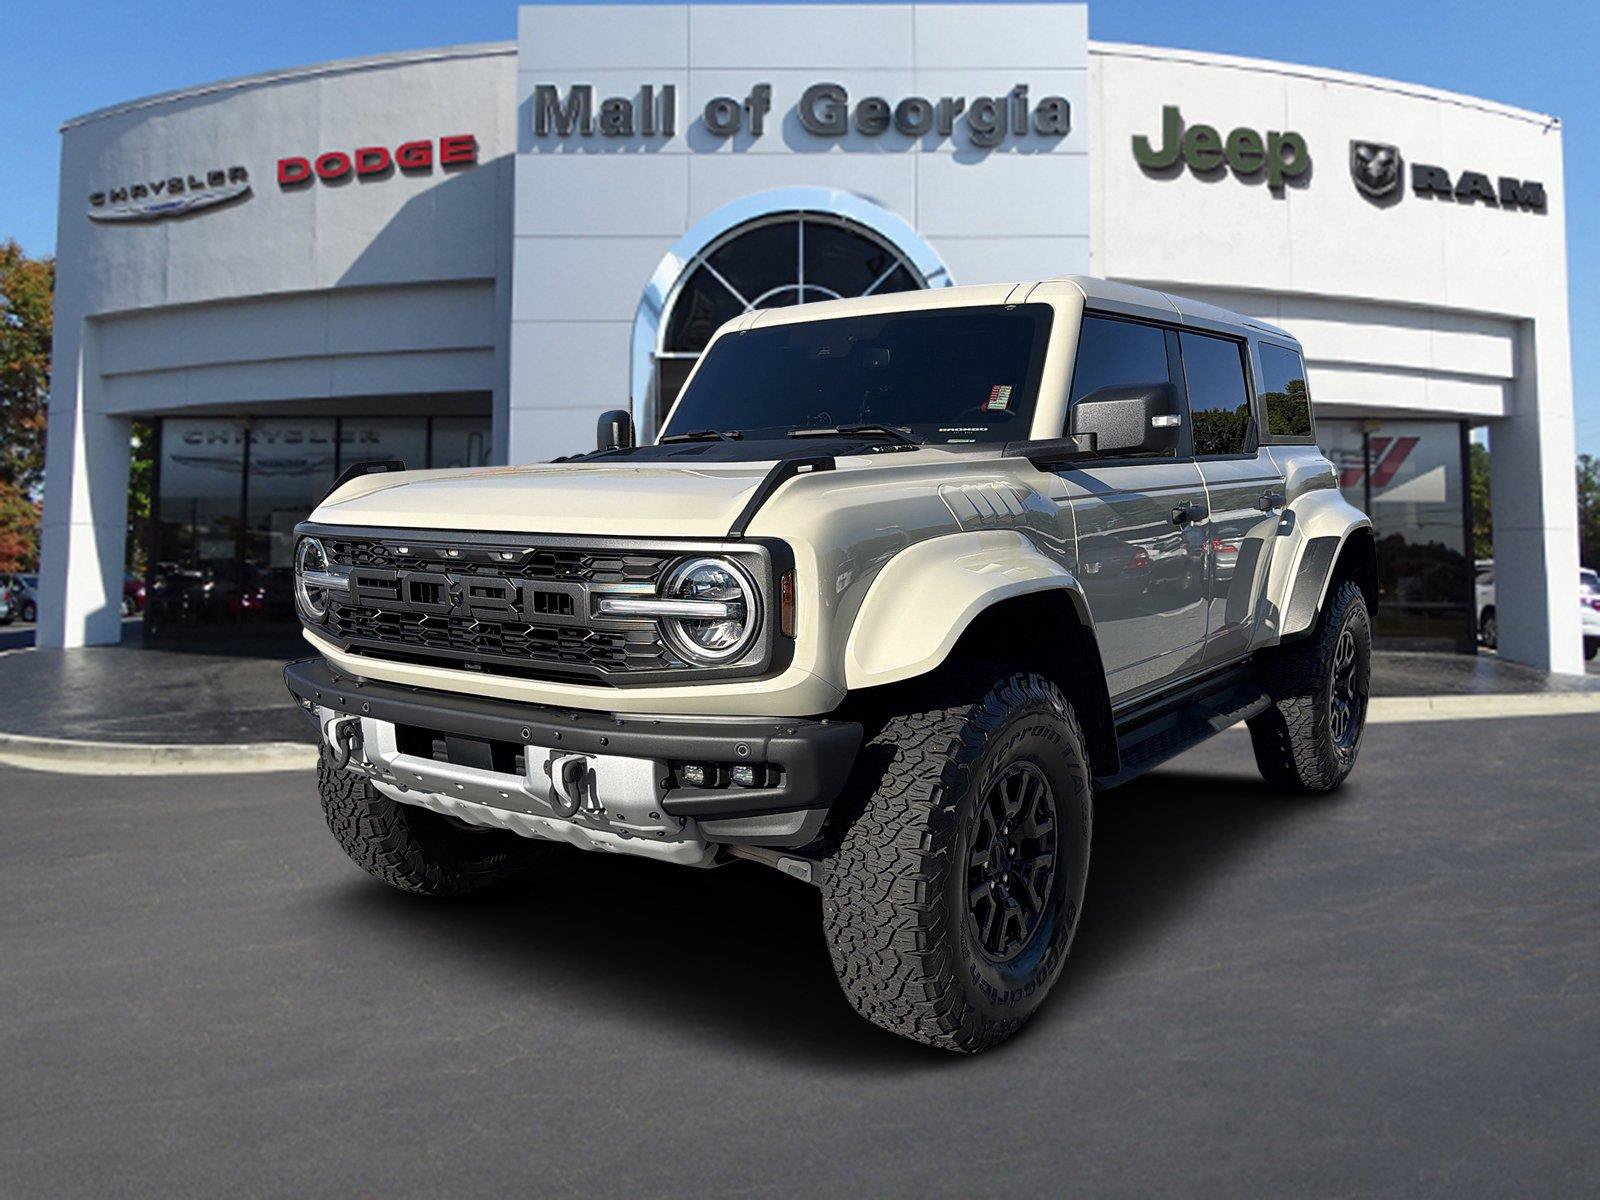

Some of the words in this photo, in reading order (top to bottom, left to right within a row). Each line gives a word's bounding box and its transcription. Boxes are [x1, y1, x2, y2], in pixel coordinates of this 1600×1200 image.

[533, 83, 677, 136] Mall
[703, 83, 772, 136] of
[800, 82, 1072, 148] Georgia
[277, 135, 476, 185] DODGE
[1131, 105, 1308, 189] Jeep
[89, 166, 249, 206] CHRYSLER
[1411, 163, 1547, 213] RAM
[183, 430, 381, 445] CHRYSLER
[348, 567, 588, 626] FORD
